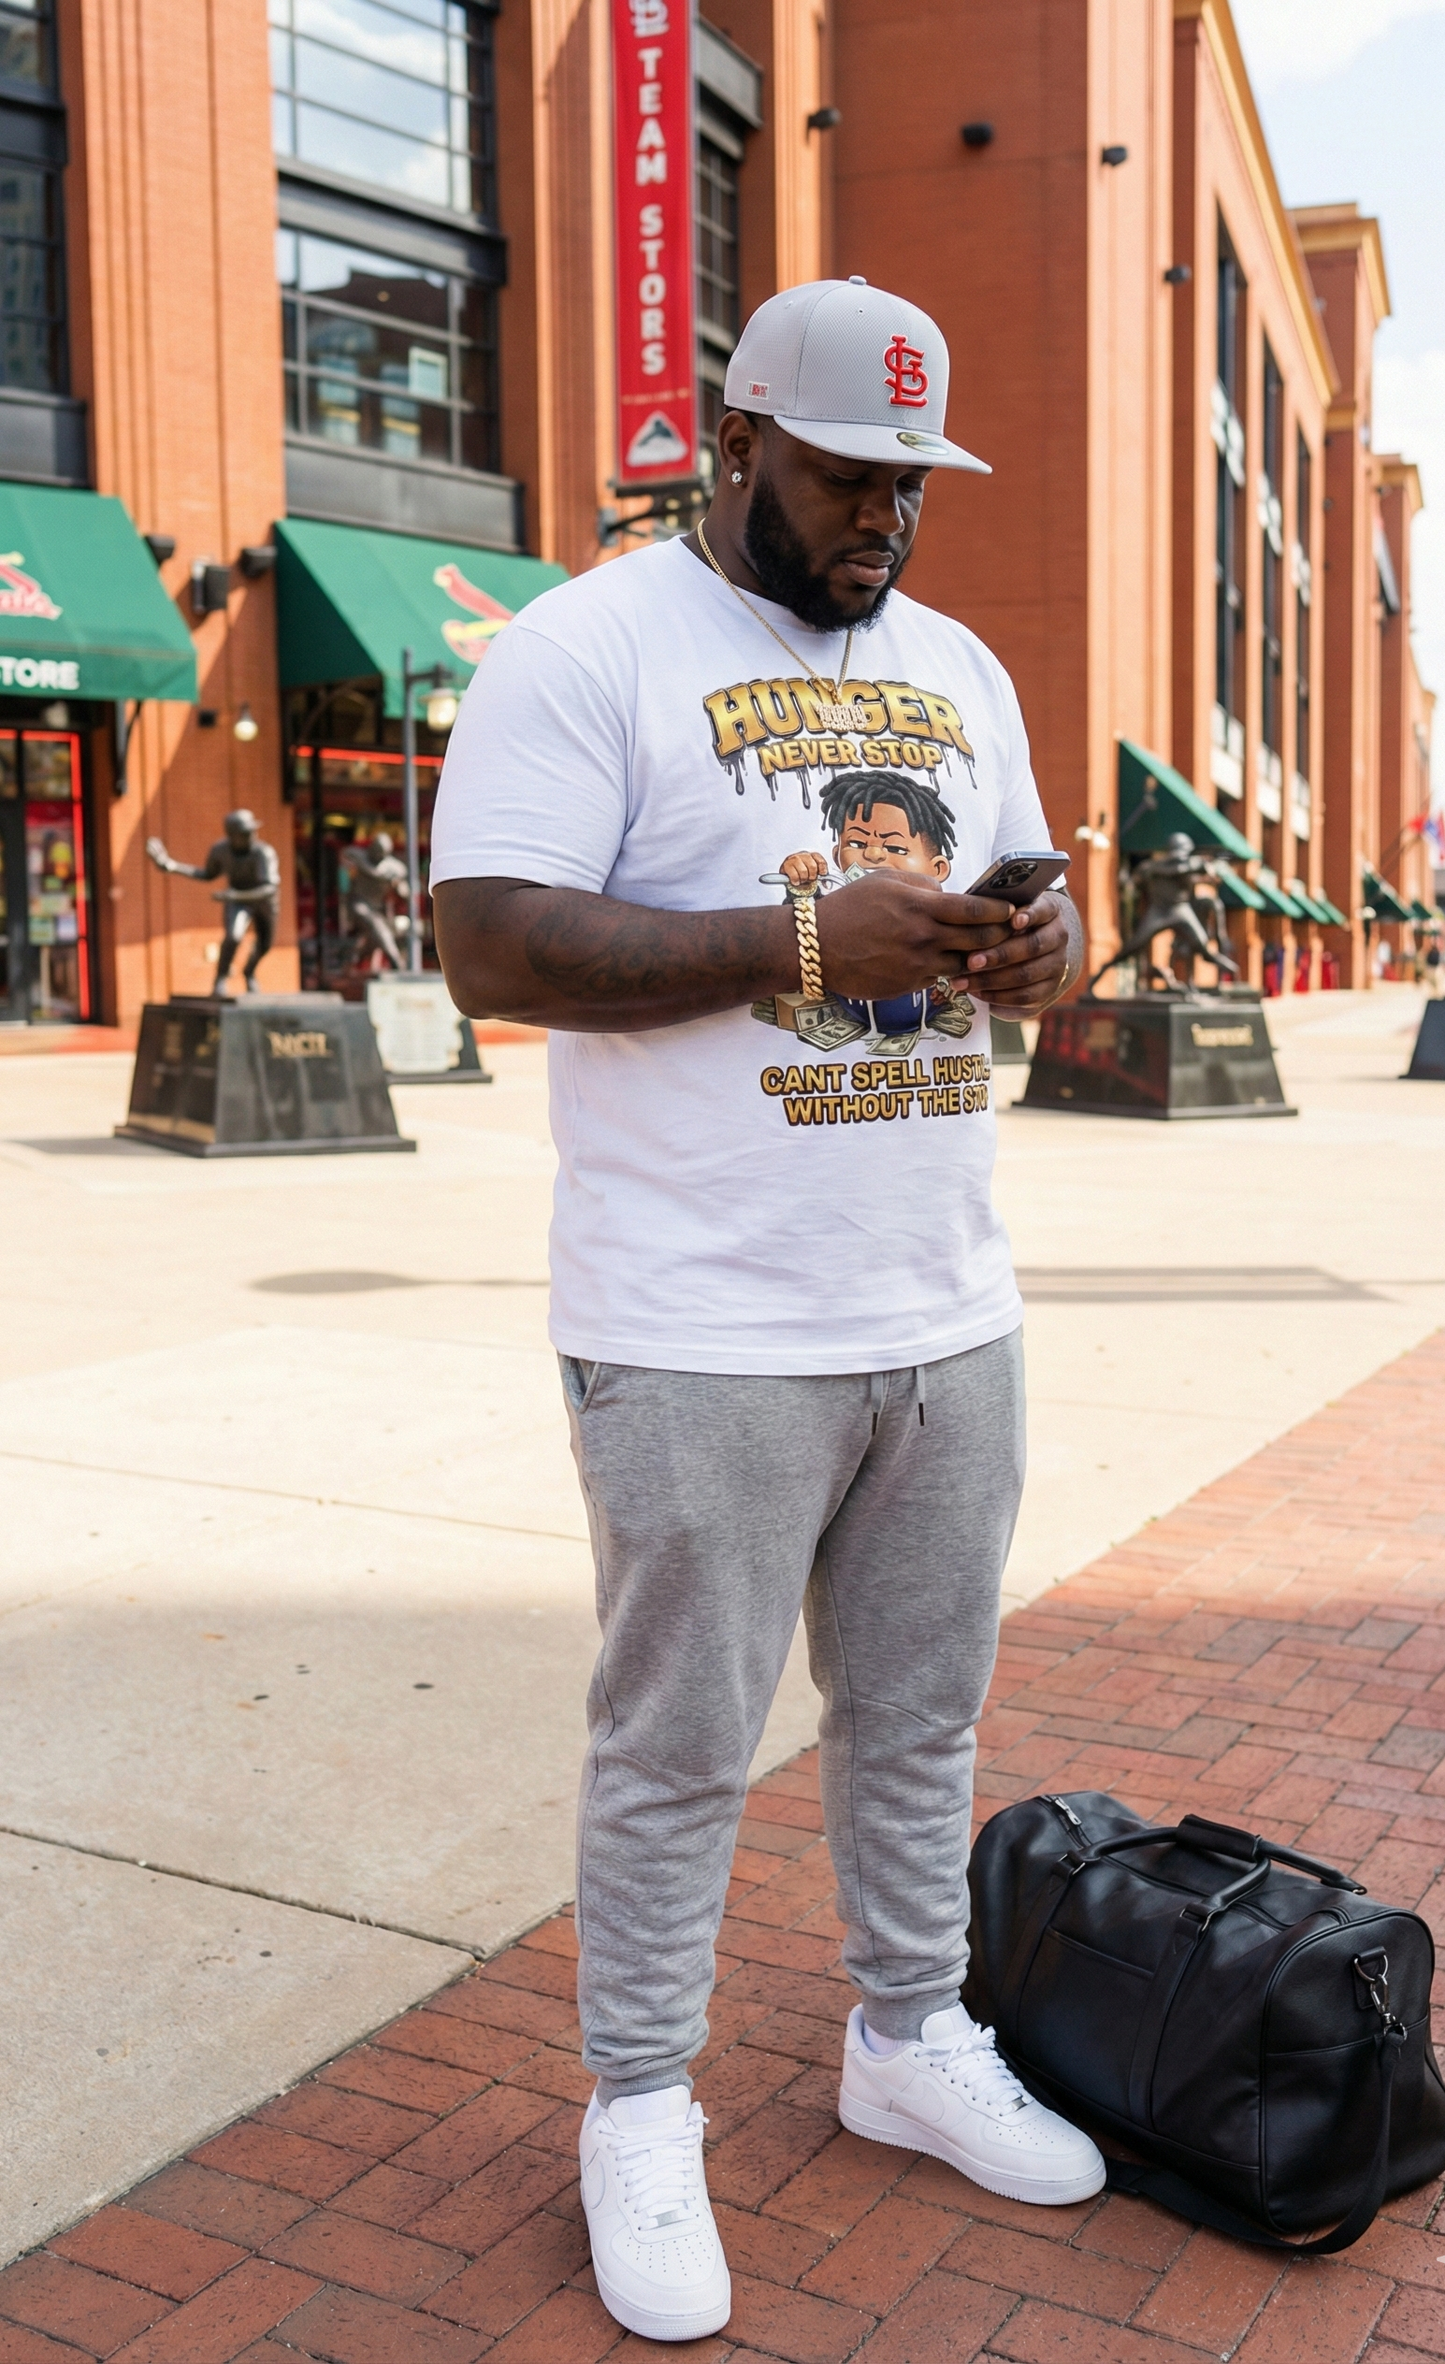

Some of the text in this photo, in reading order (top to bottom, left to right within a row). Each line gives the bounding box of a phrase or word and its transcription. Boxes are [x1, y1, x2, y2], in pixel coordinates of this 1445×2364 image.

[636, 46, 668, 187] TEAM
[638, 203, 667, 376] STORS
[0, 656, 80, 690] TORE
[702, 677, 975, 760] HUNGER
[758, 737, 944, 777] NEVER STOP
[760, 1063, 847, 1096] CANT
[850, 1058, 931, 1093] SPELL
[782, 1090, 914, 1127] WITHOUT
[916, 1086, 961, 1118] THE
